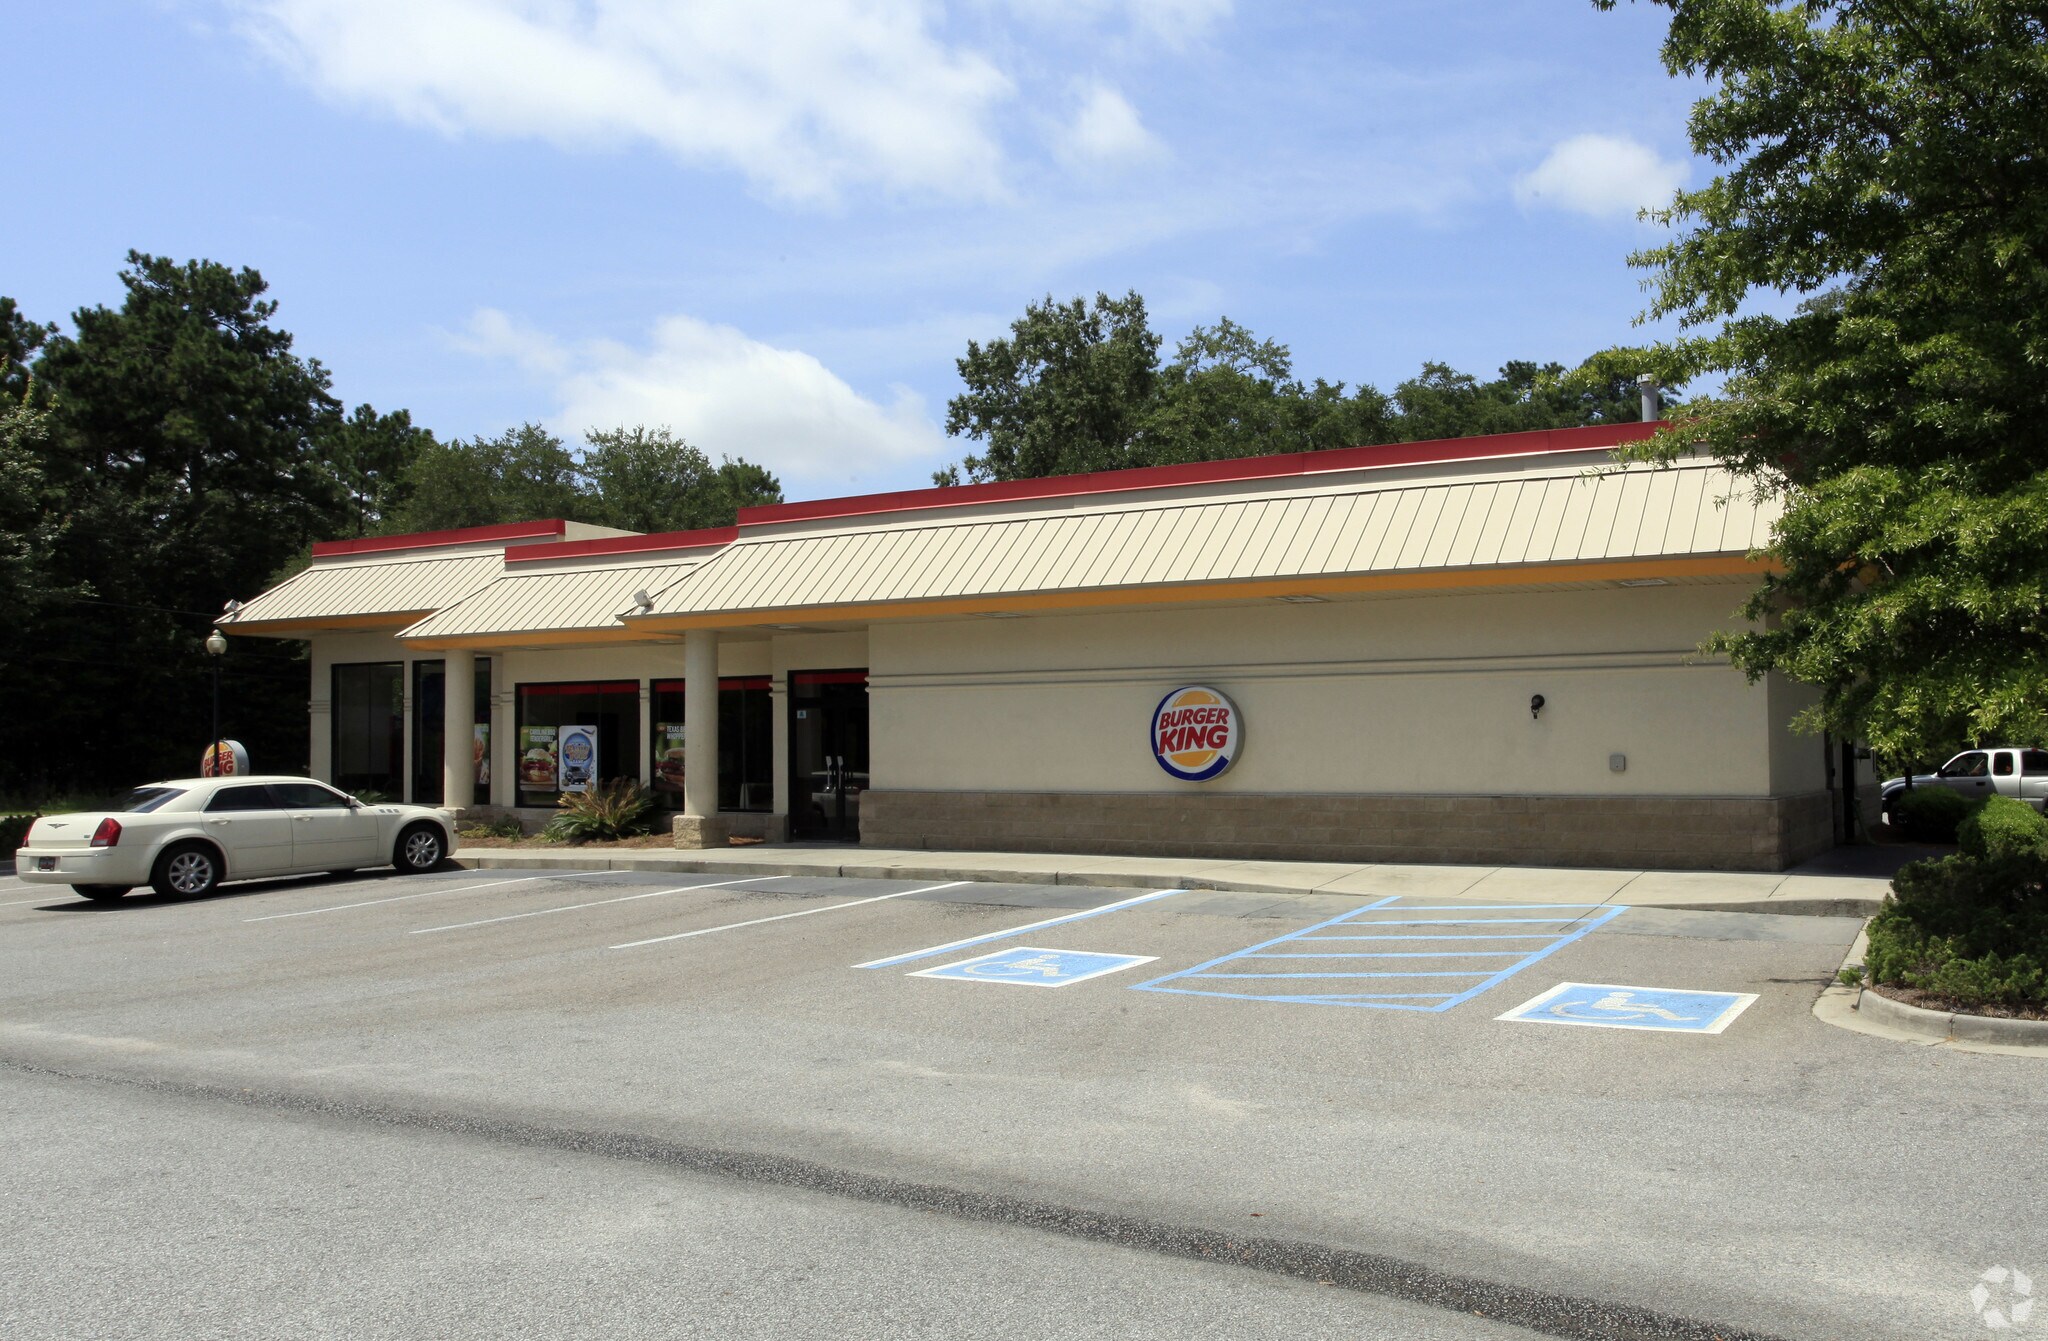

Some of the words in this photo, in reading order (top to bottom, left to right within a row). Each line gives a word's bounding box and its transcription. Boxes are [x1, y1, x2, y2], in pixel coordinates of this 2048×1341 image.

[1159, 708, 1230, 730] BURGER
[1158, 725, 1229, 754] KING
[205, 751, 233, 768] BUGER
